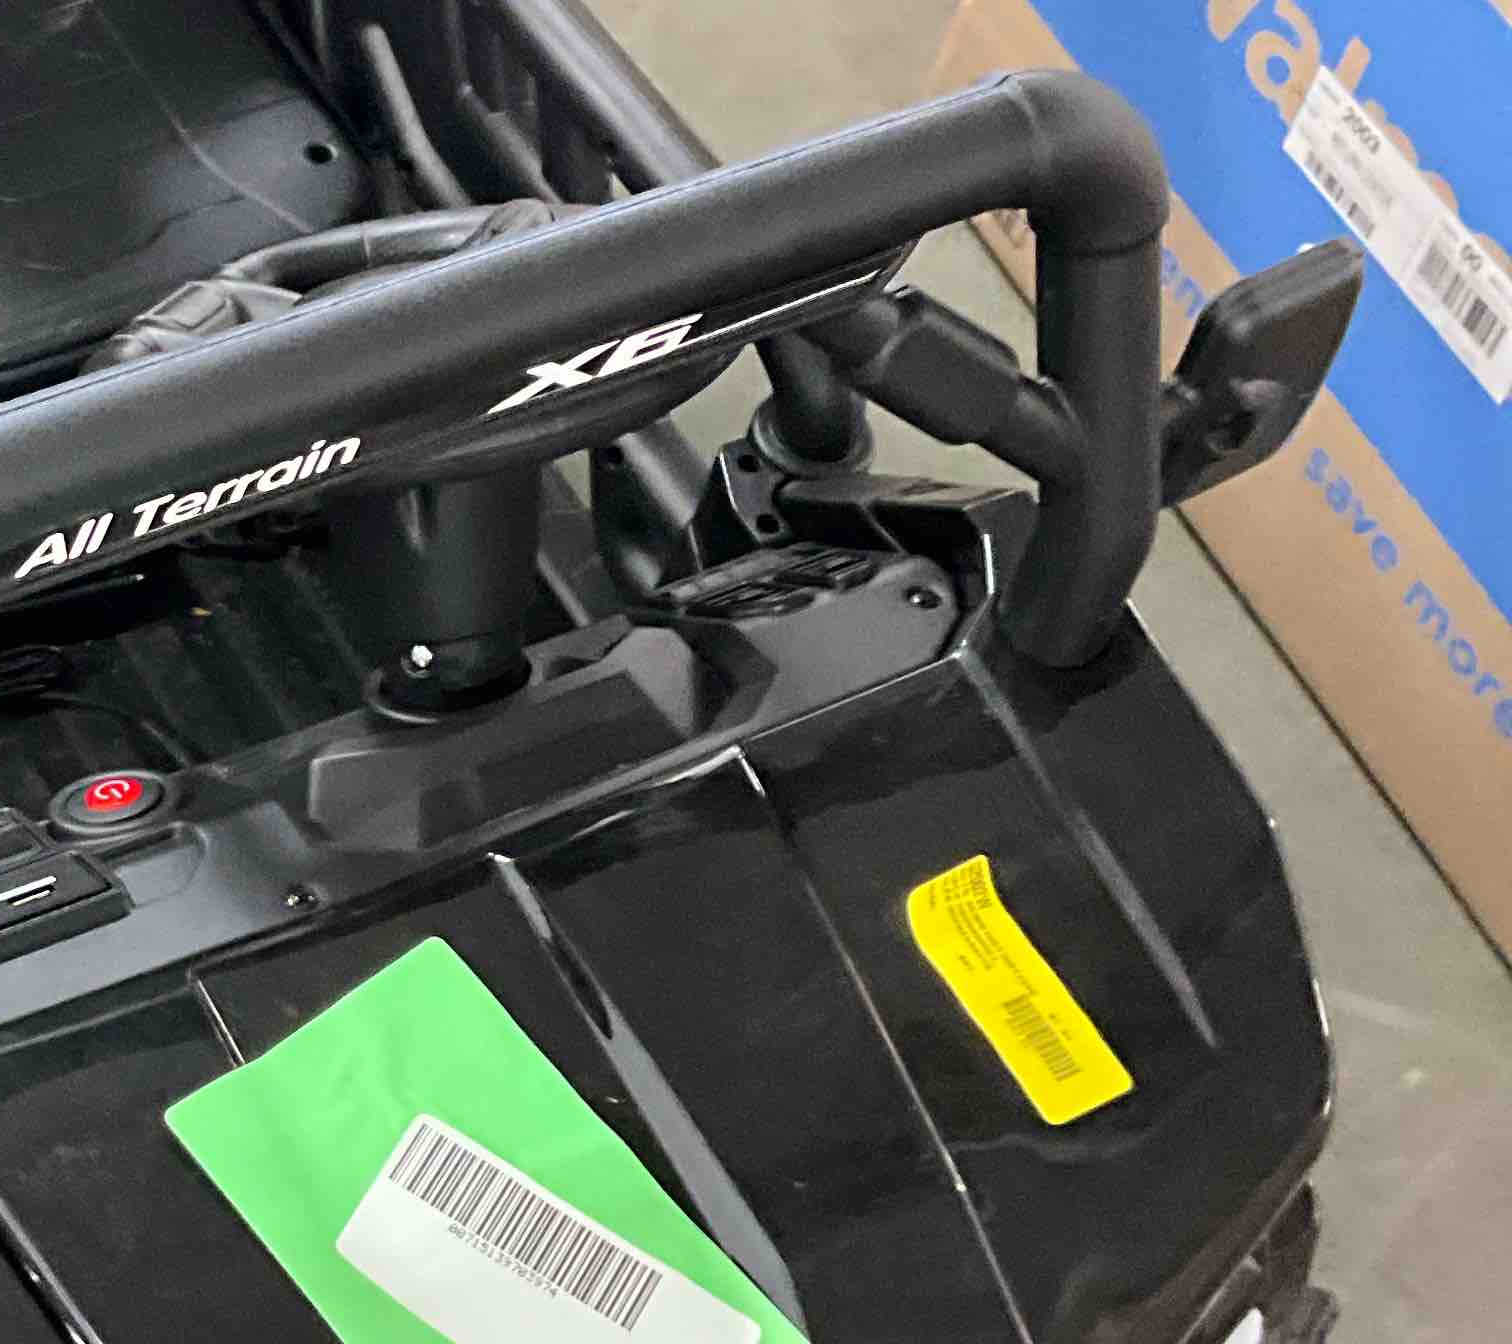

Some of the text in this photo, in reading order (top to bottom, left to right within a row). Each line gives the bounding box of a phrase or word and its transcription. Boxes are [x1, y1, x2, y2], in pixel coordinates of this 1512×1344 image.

[14, 435, 362, 580] All Terrain
[1303, 447, 1399, 573] save
